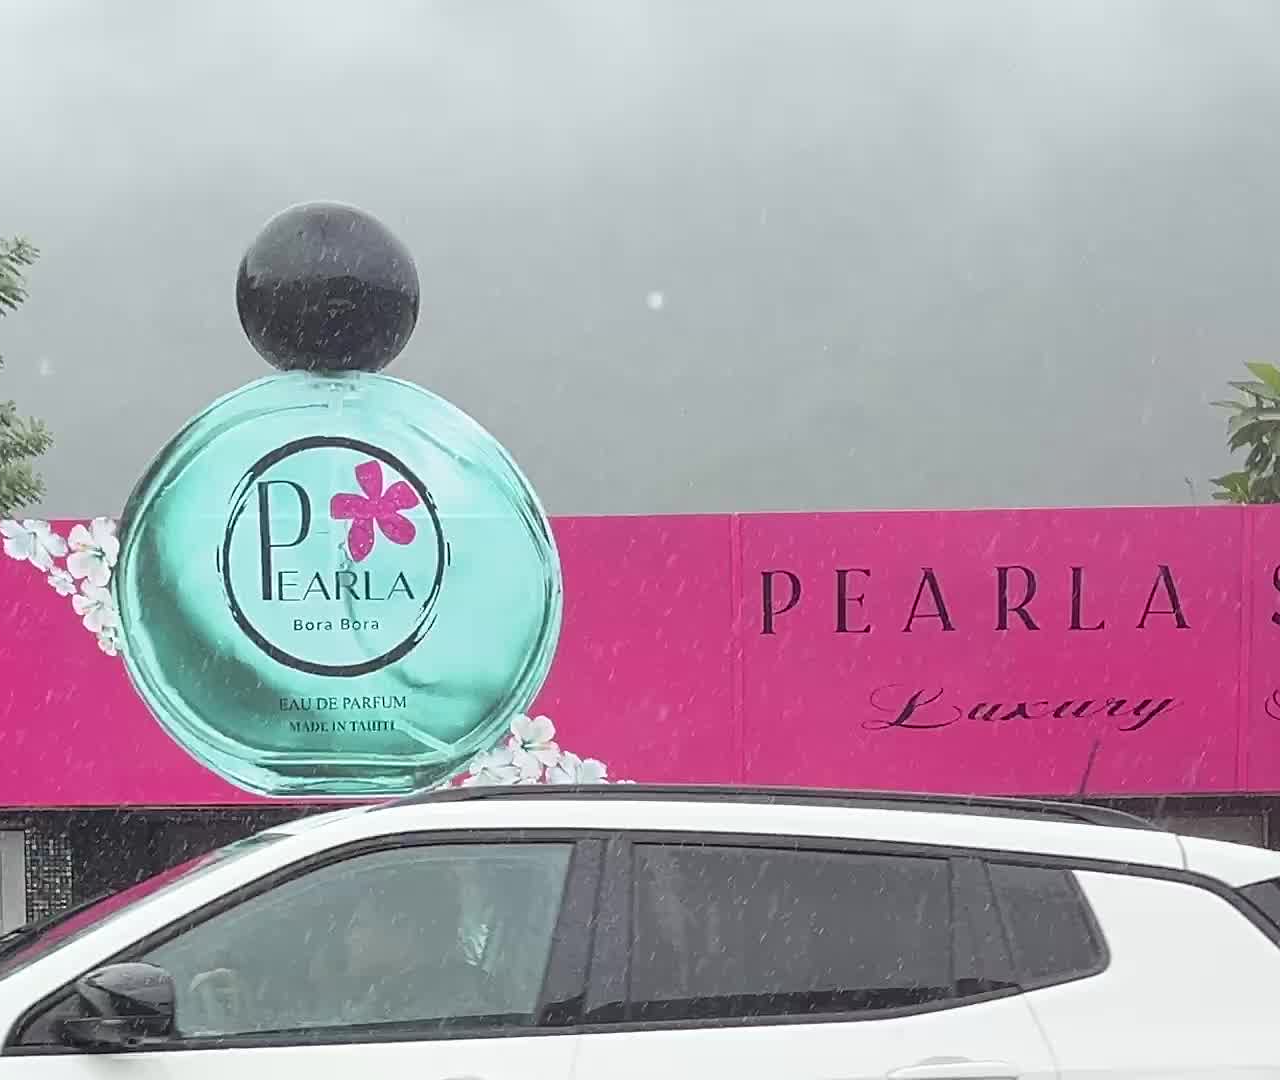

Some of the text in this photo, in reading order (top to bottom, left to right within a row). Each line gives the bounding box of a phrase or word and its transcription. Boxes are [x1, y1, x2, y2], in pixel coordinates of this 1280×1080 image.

[256, 480, 416, 602] PEARLA
[758, 564, 1192, 635] PEARLA
[293, 618, 380, 631] Bora Bora
[279, 695, 407, 711] EAU DE PARFUM
[860, 682, 1184, 732] Luxury
[289, 720, 329, 733] MADE
[332, 720, 346, 732] IN
